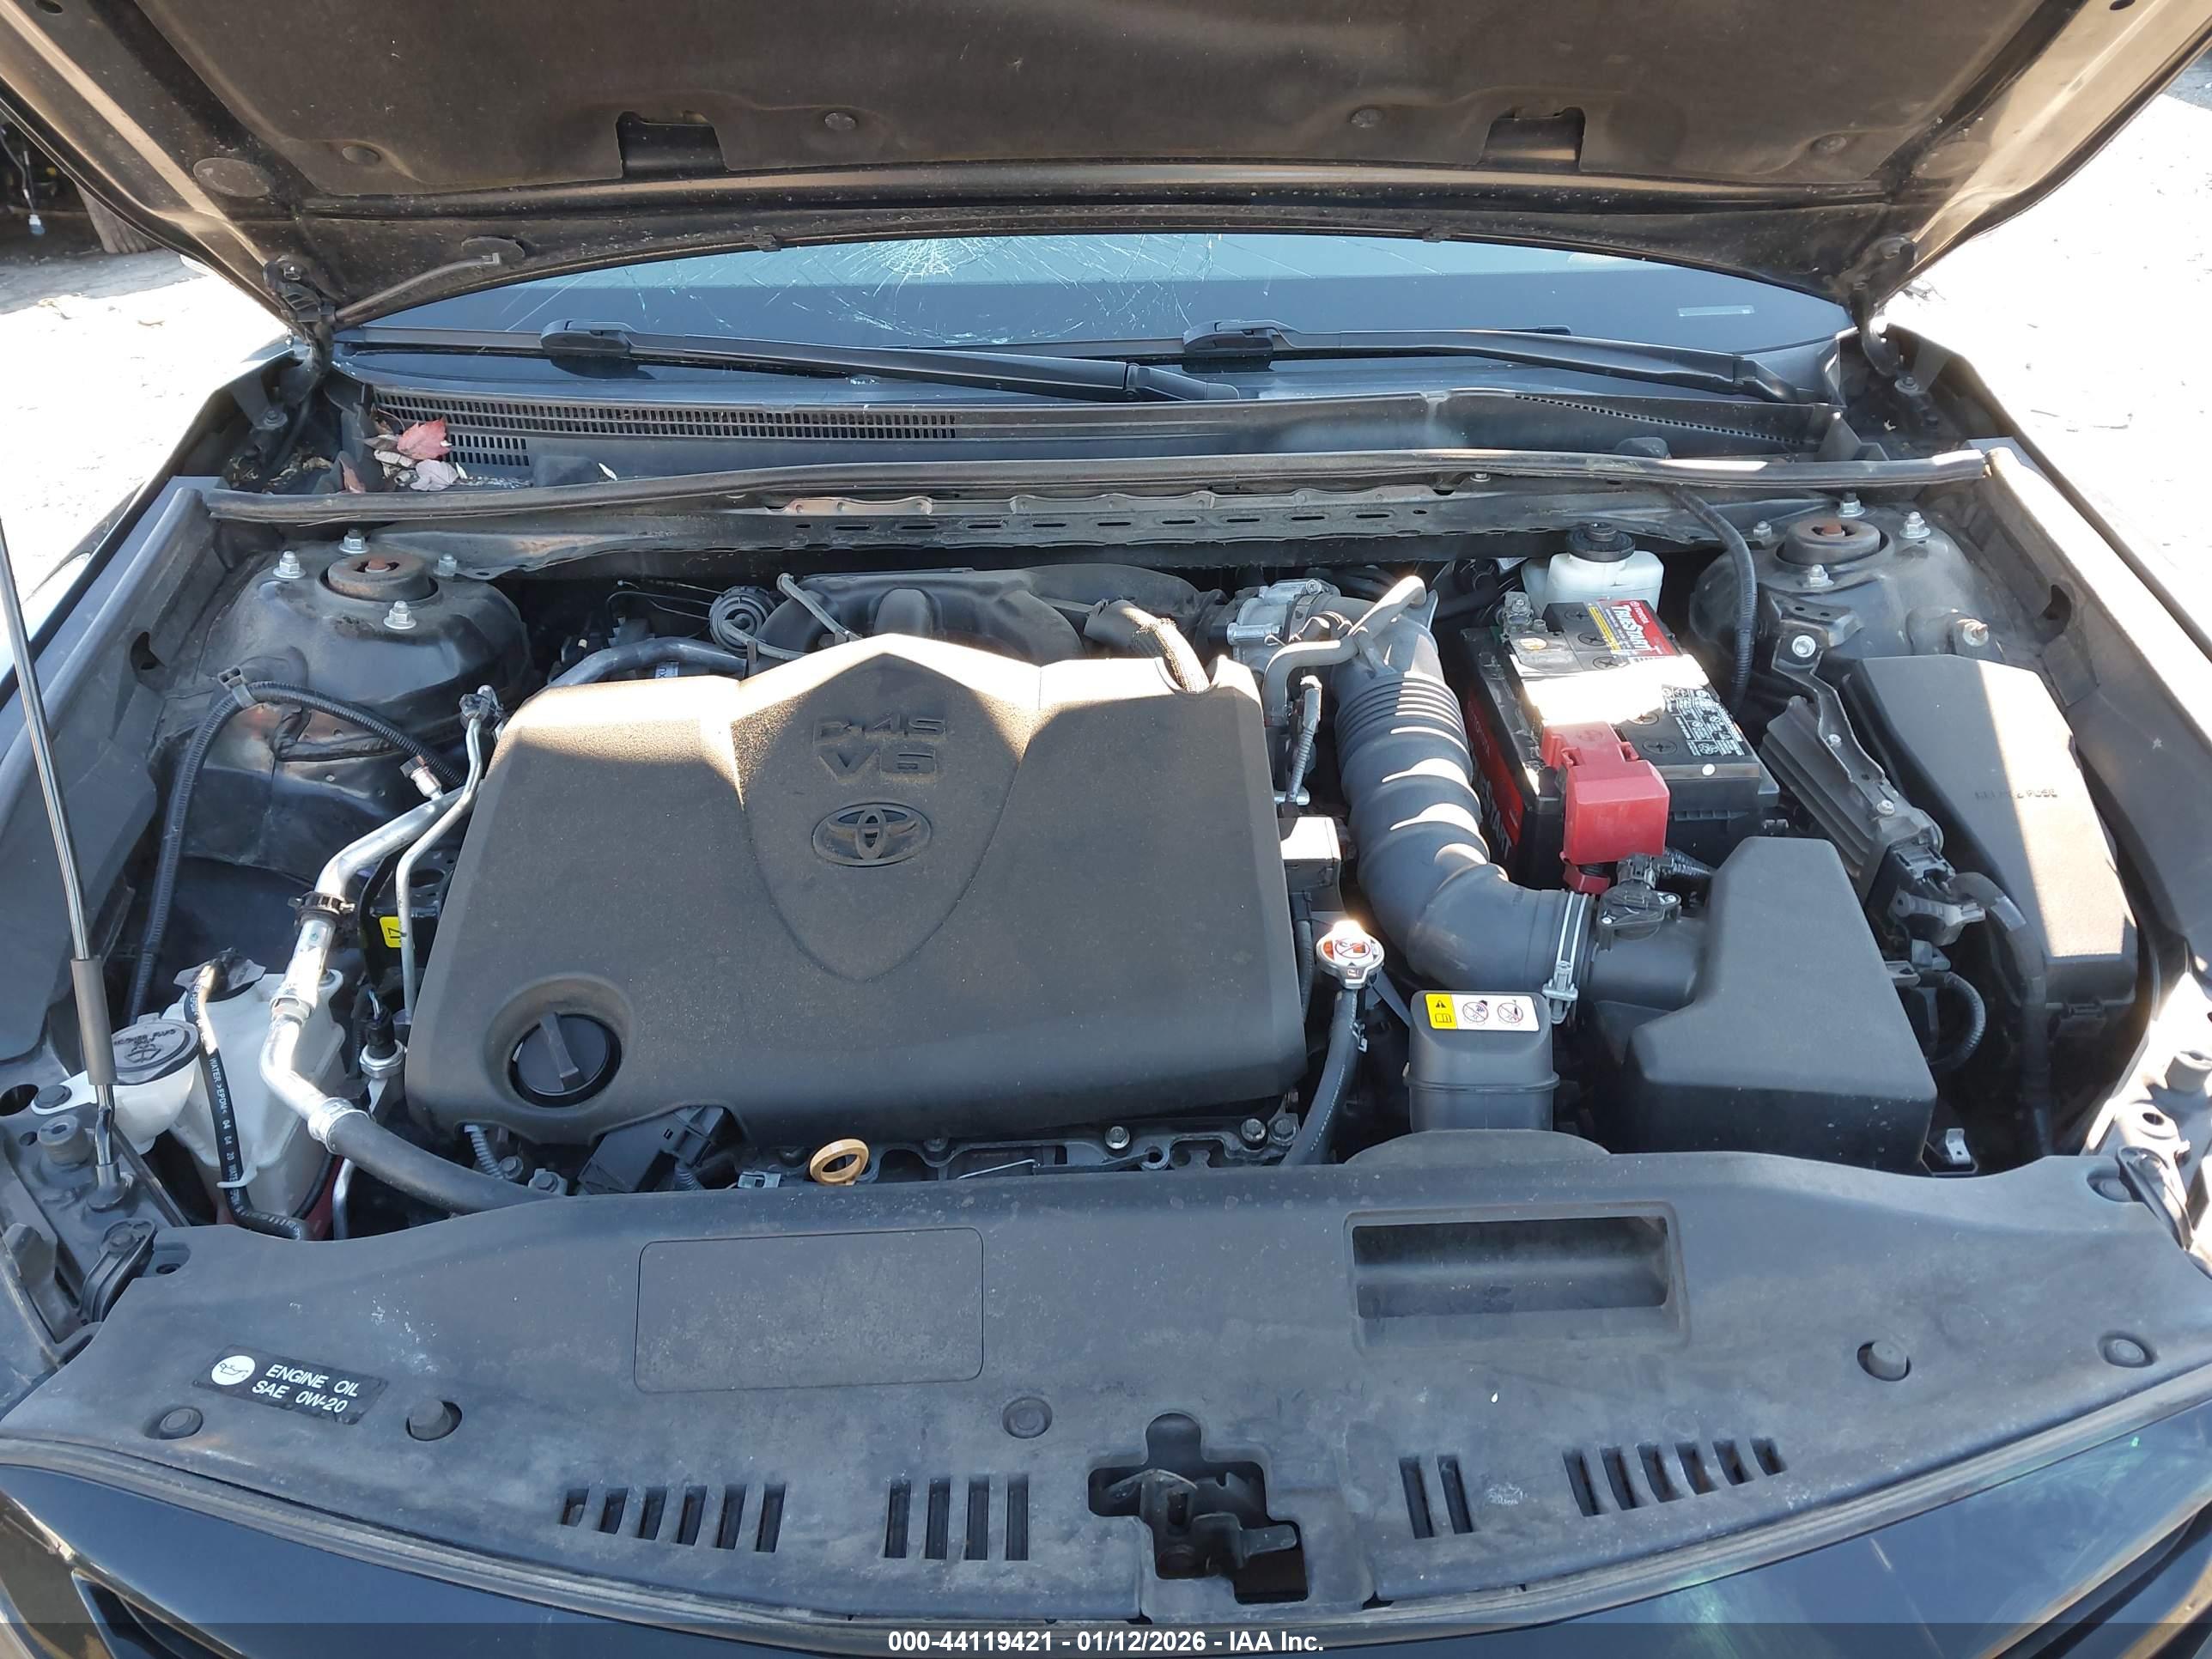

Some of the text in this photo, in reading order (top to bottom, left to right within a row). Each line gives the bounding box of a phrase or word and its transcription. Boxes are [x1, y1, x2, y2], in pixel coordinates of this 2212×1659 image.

[818, 744, 938, 781] V6
[252, 1380, 348, 1413] SAE 0W-20
[266, 1364, 359, 1397] ENGINE OIL
